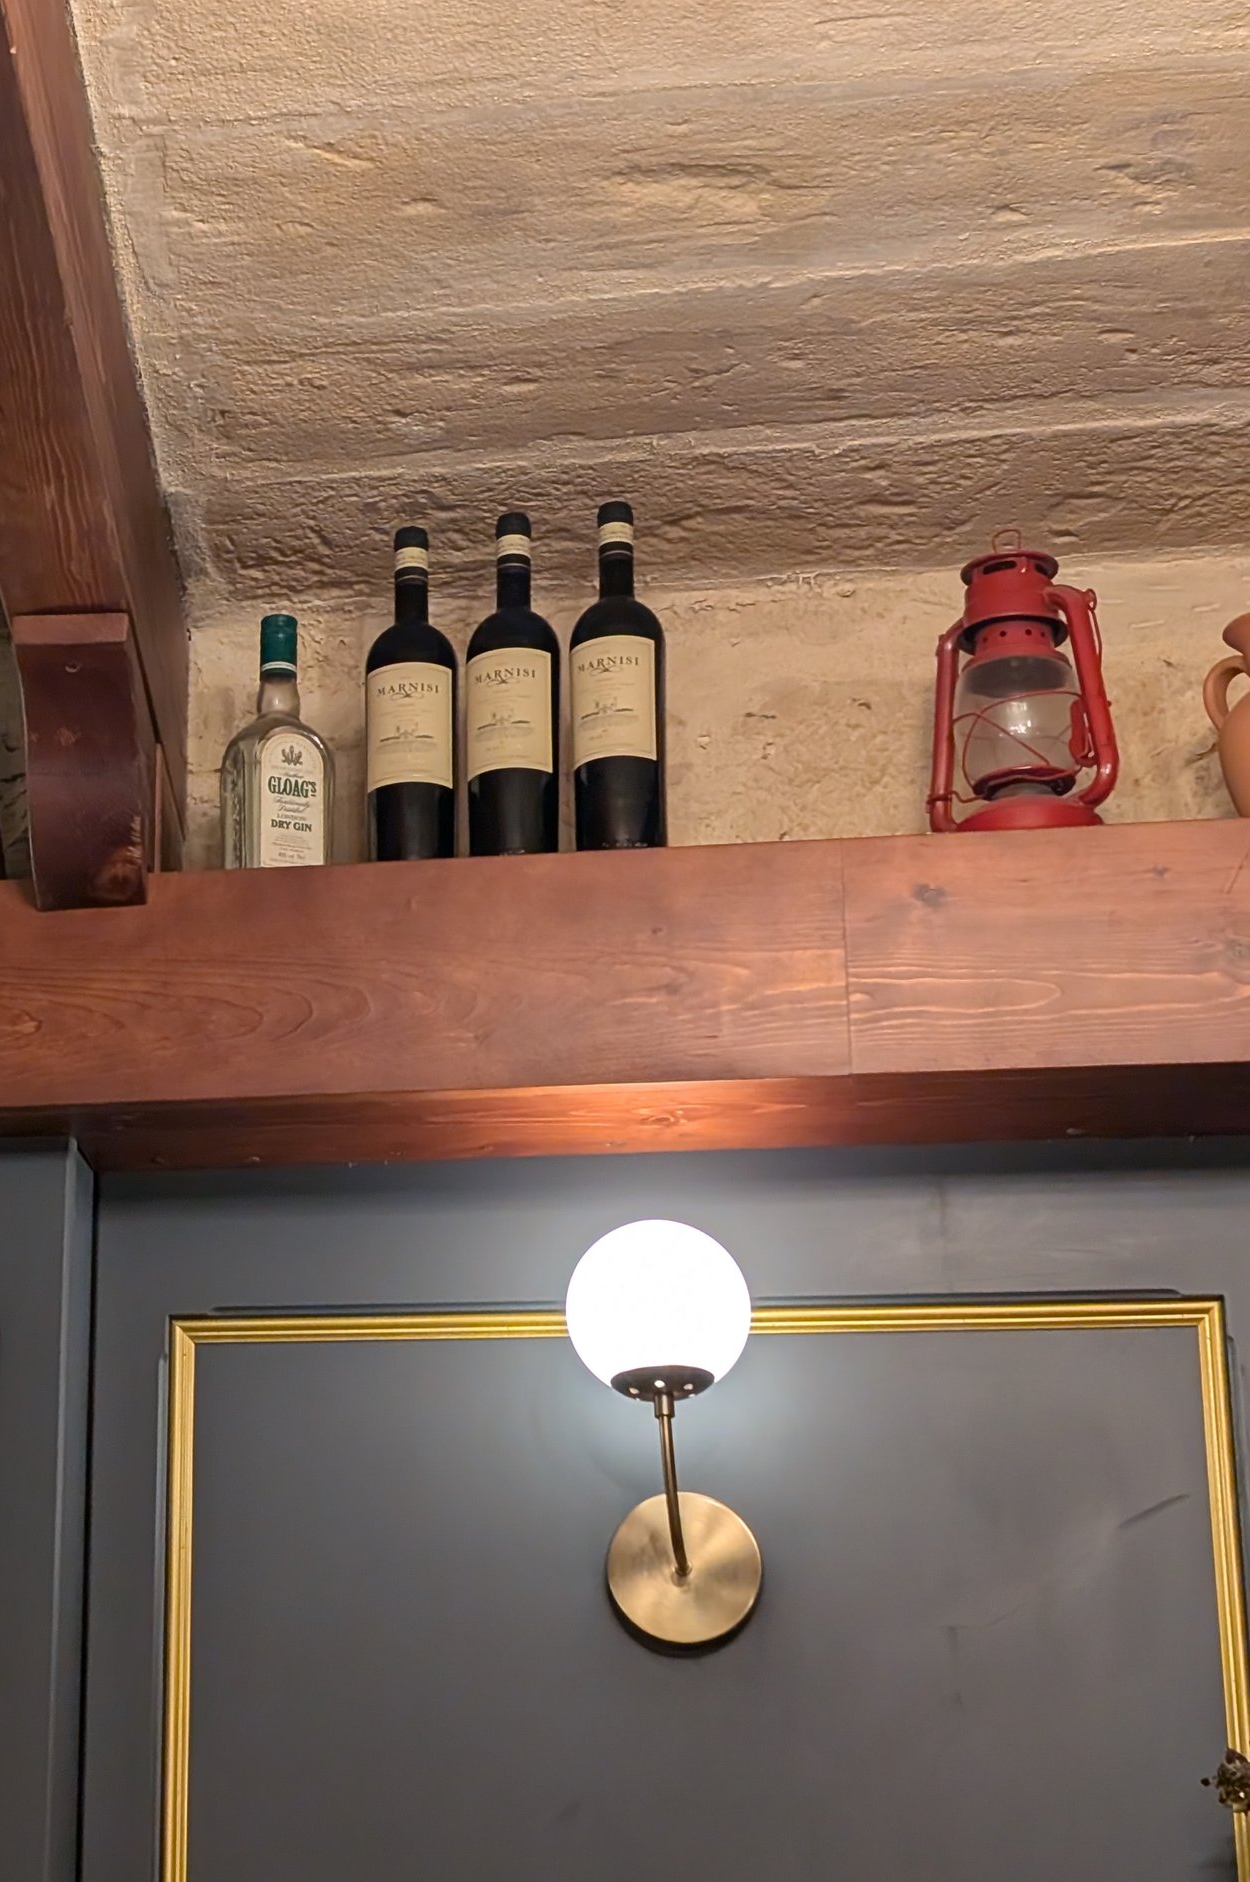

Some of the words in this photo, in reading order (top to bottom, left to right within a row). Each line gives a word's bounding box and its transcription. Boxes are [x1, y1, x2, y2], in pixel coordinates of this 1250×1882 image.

[576, 655, 640, 673] MARNISI
[474, 667, 537, 685] MARNISI
[376, 682, 440, 697] MARNISI
[268, 776, 317, 798] GLOAG'S
[271, 819, 292, 829] DRY
[293, 821, 312, 832] GIN
